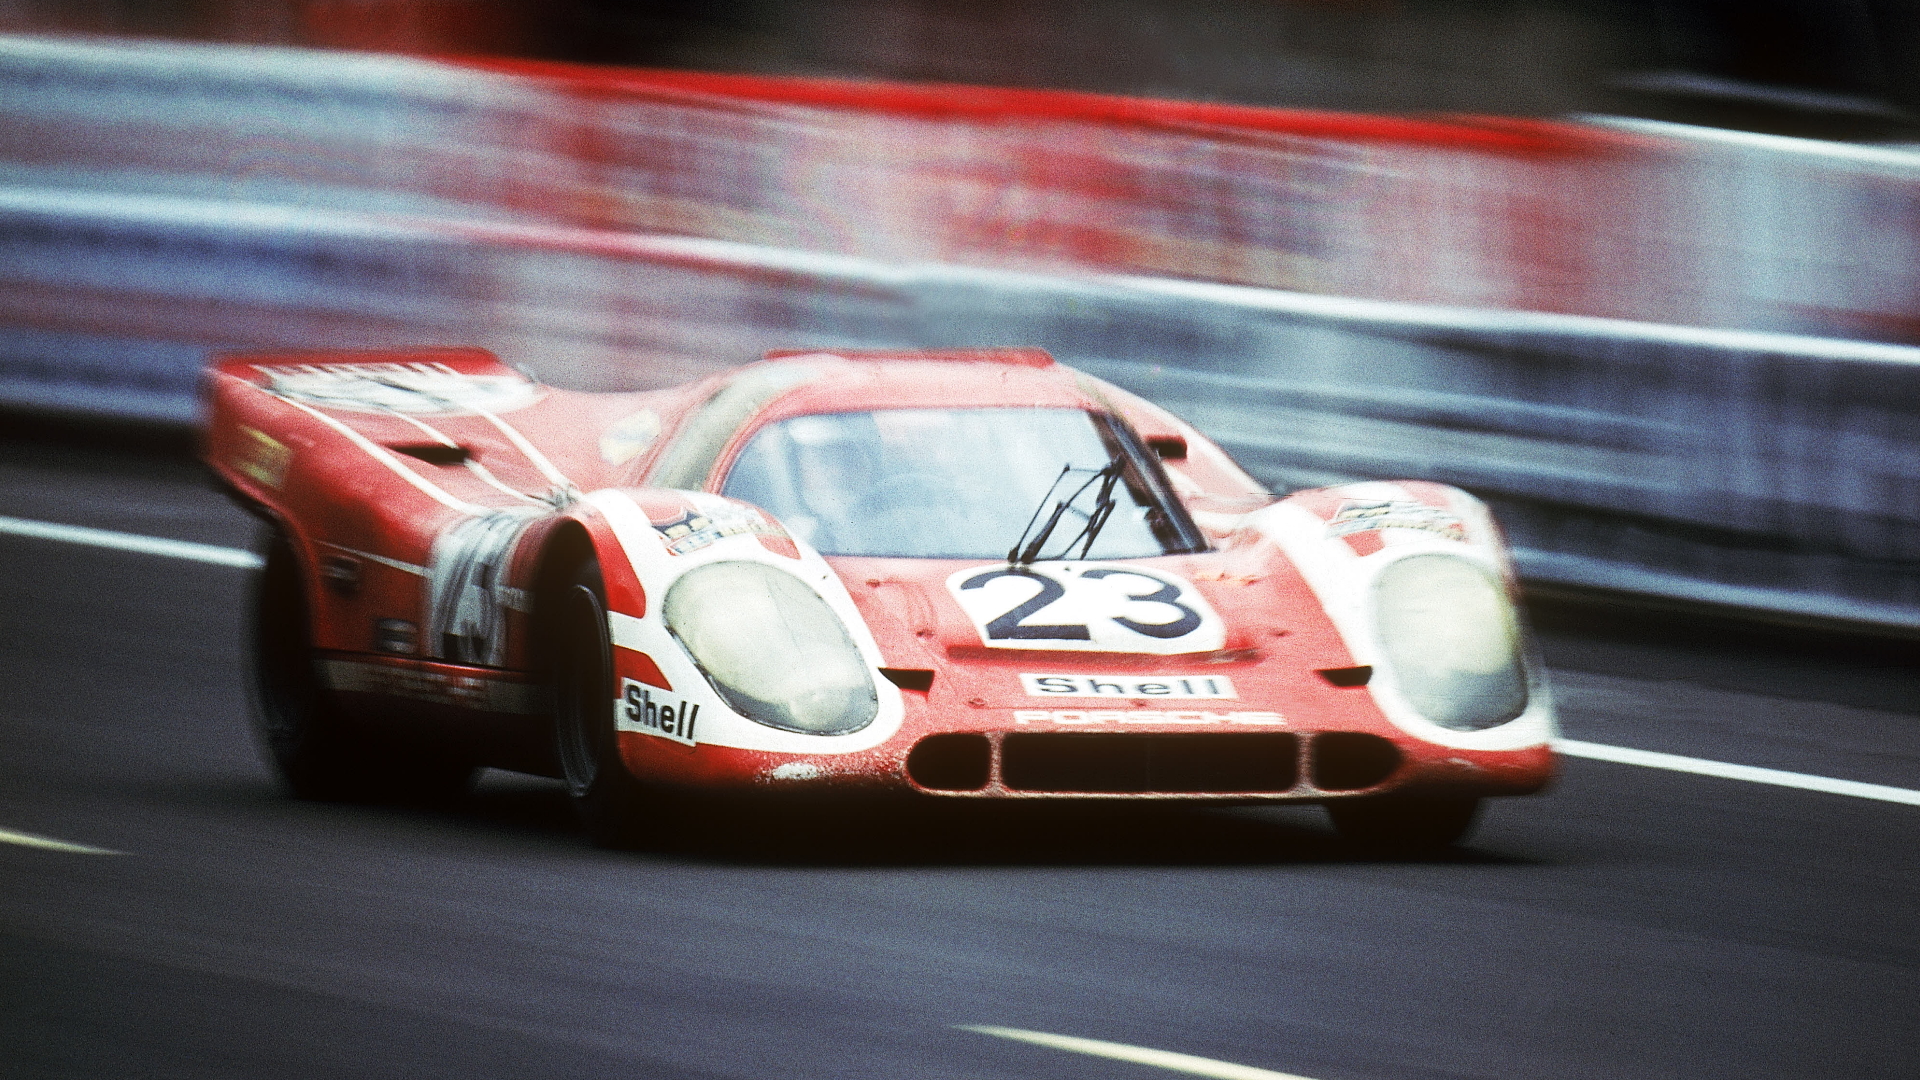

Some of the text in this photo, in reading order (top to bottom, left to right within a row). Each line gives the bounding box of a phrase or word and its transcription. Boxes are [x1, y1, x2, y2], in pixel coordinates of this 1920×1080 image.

[961, 566, 1202, 641] 23
[1035, 677, 1222, 695] Shell
[625, 684, 700, 741] Shell
[1013, 710, 1288, 725] PORSCHE
